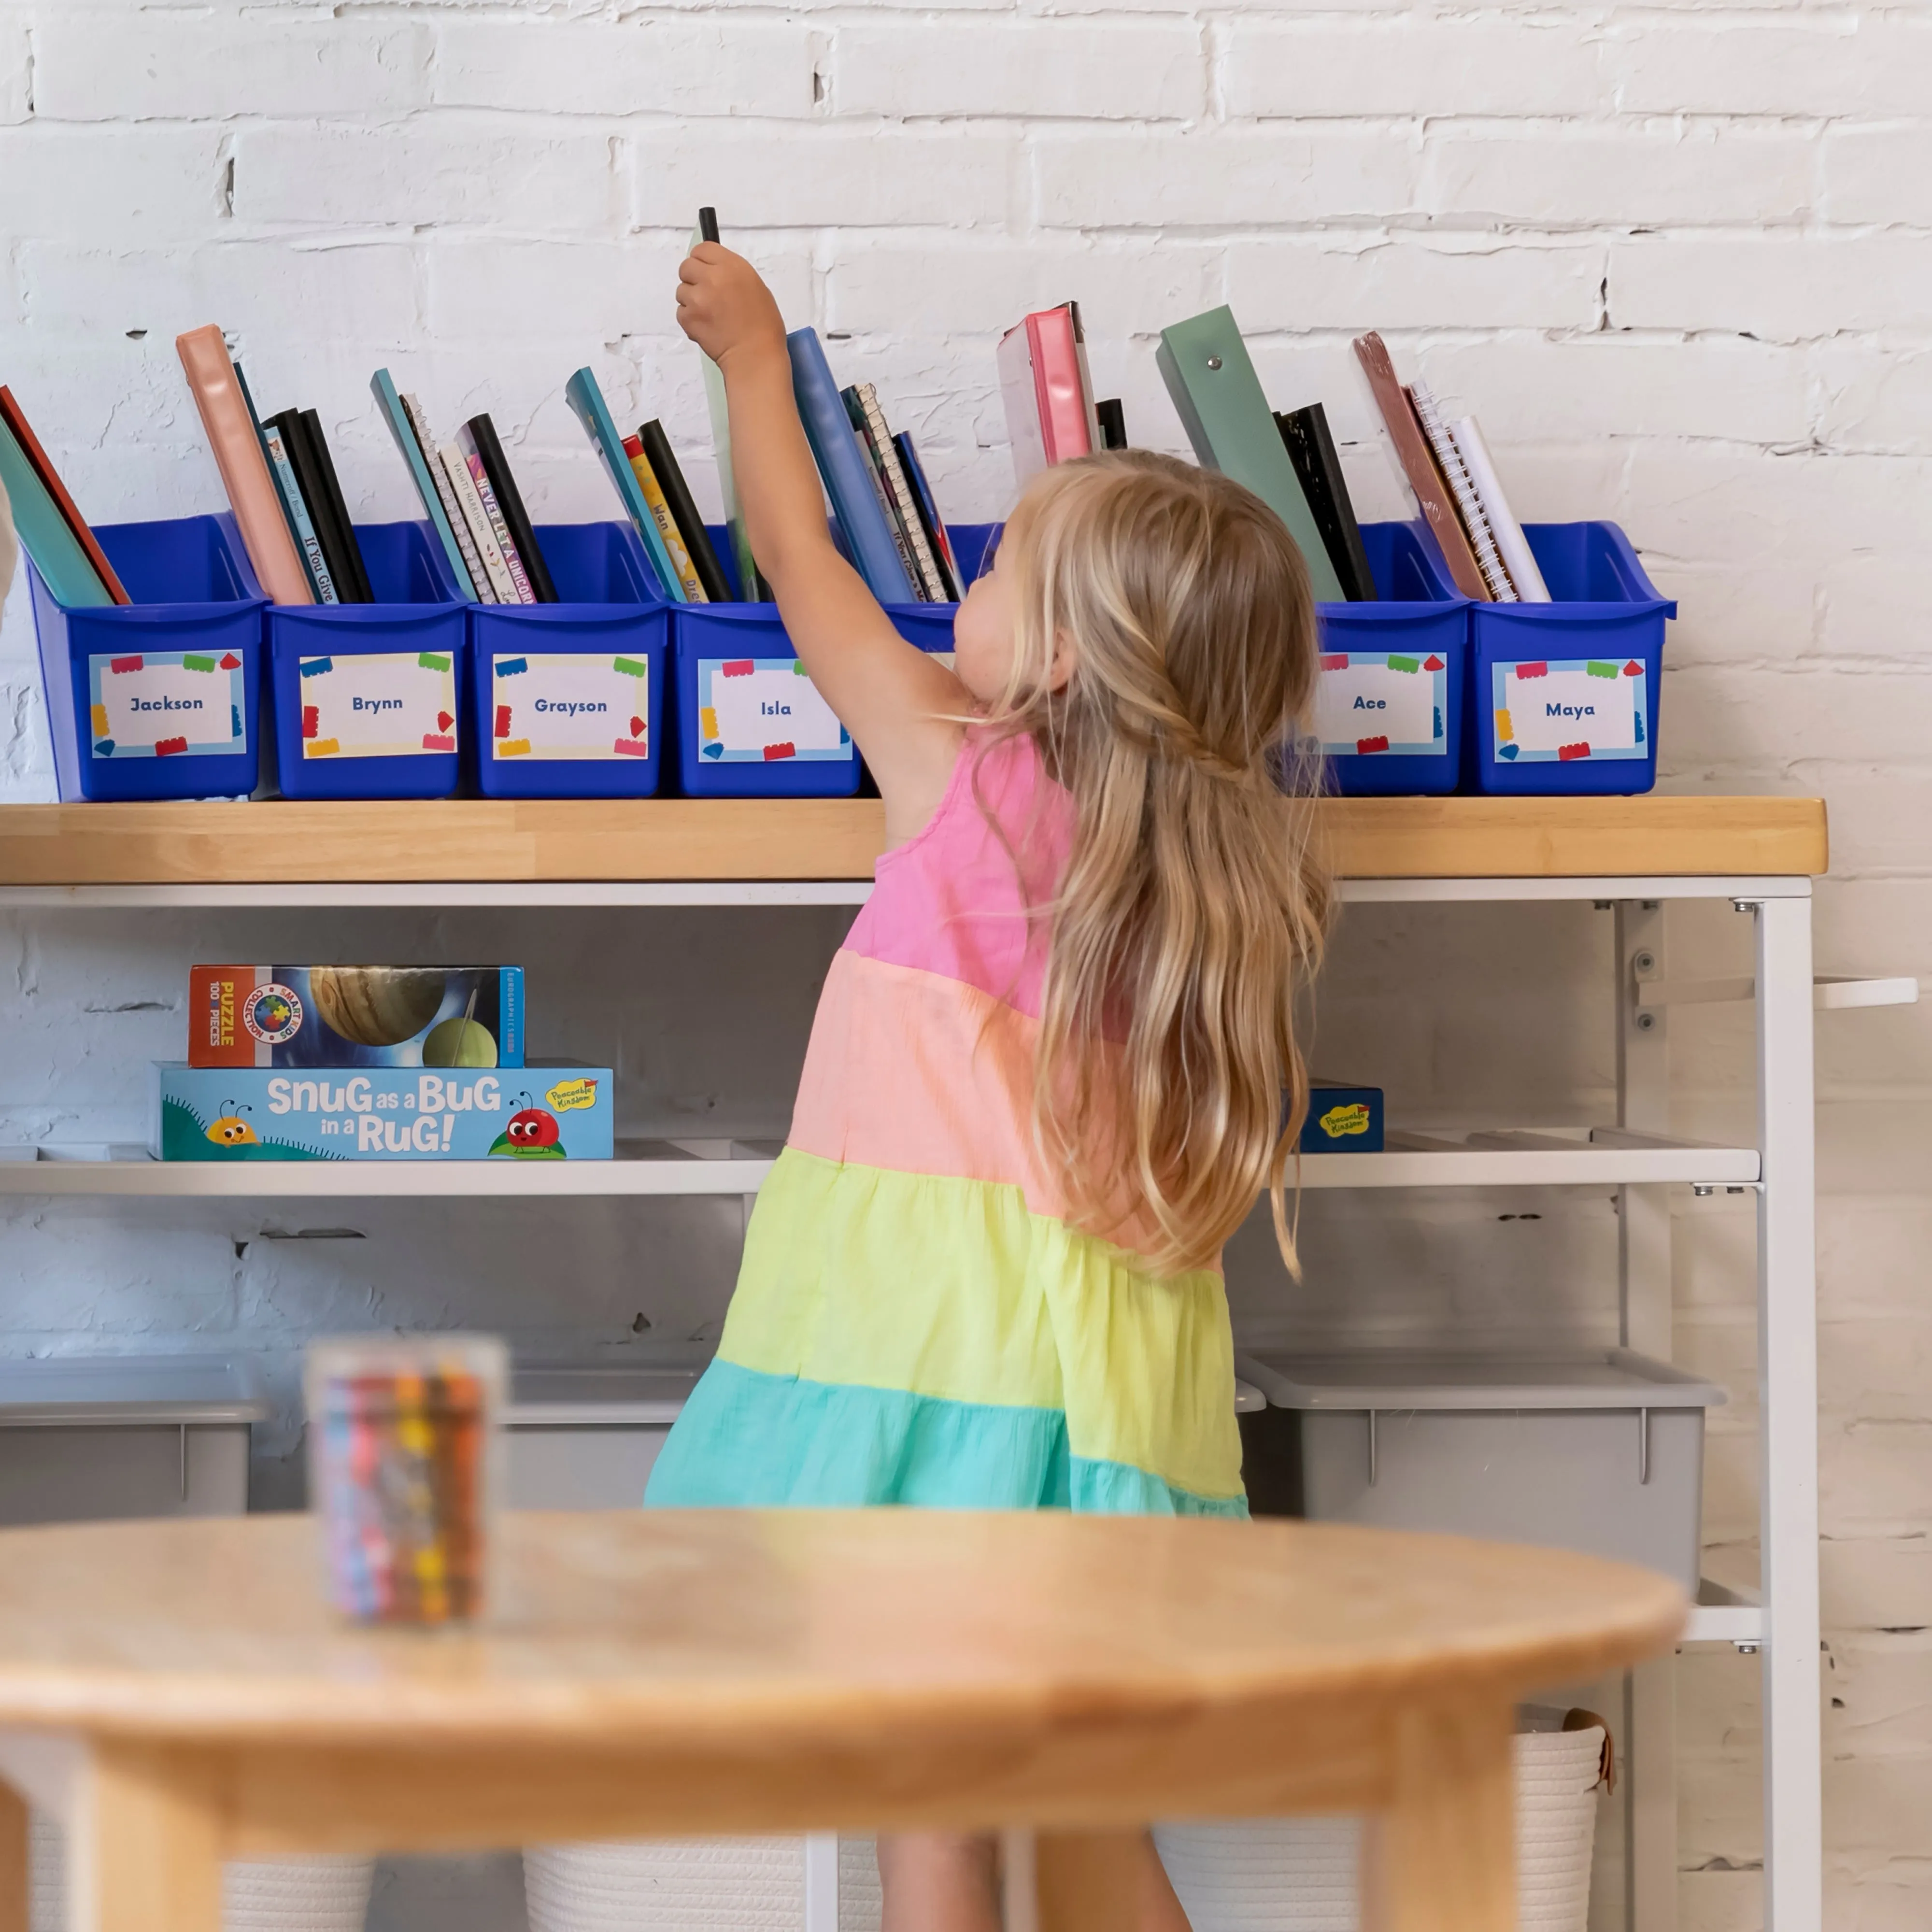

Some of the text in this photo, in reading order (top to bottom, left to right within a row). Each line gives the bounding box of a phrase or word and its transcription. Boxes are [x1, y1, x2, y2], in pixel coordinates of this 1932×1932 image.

[454, 461, 485, 531] VASHTI HARRISON
[292, 499, 303, 518] Bond
[653, 504, 668, 530] Wan
[476, 478, 500, 520] NEVER
[494, 522, 511, 545] LET
[504, 550, 514, 559] A
[304, 536, 333, 602] If You Give
[130, 696, 203, 712] Jackson
[353, 697, 403, 714] Brynn
[534, 699, 607, 717] Grayson
[761, 702, 791, 716] Isla
[1353, 696, 1386, 710] Ace
[1546, 703, 1595, 719] Maya
[210, 981, 220, 1046] 100 PIECES
[220, 981, 234, 1046] PUZZLE
[244, 989, 265, 1038] COLLECTION
[279, 987, 301, 1040] SMART KIDS
[376, 1093, 398, 1108] as
[404, 1093, 415, 1108] a
[551, 1083, 592, 1100] Peaceable
[557, 1095, 590, 1108] Kingdom
[321, 1119, 339, 1135] in
[343, 1119, 355, 1135] a
